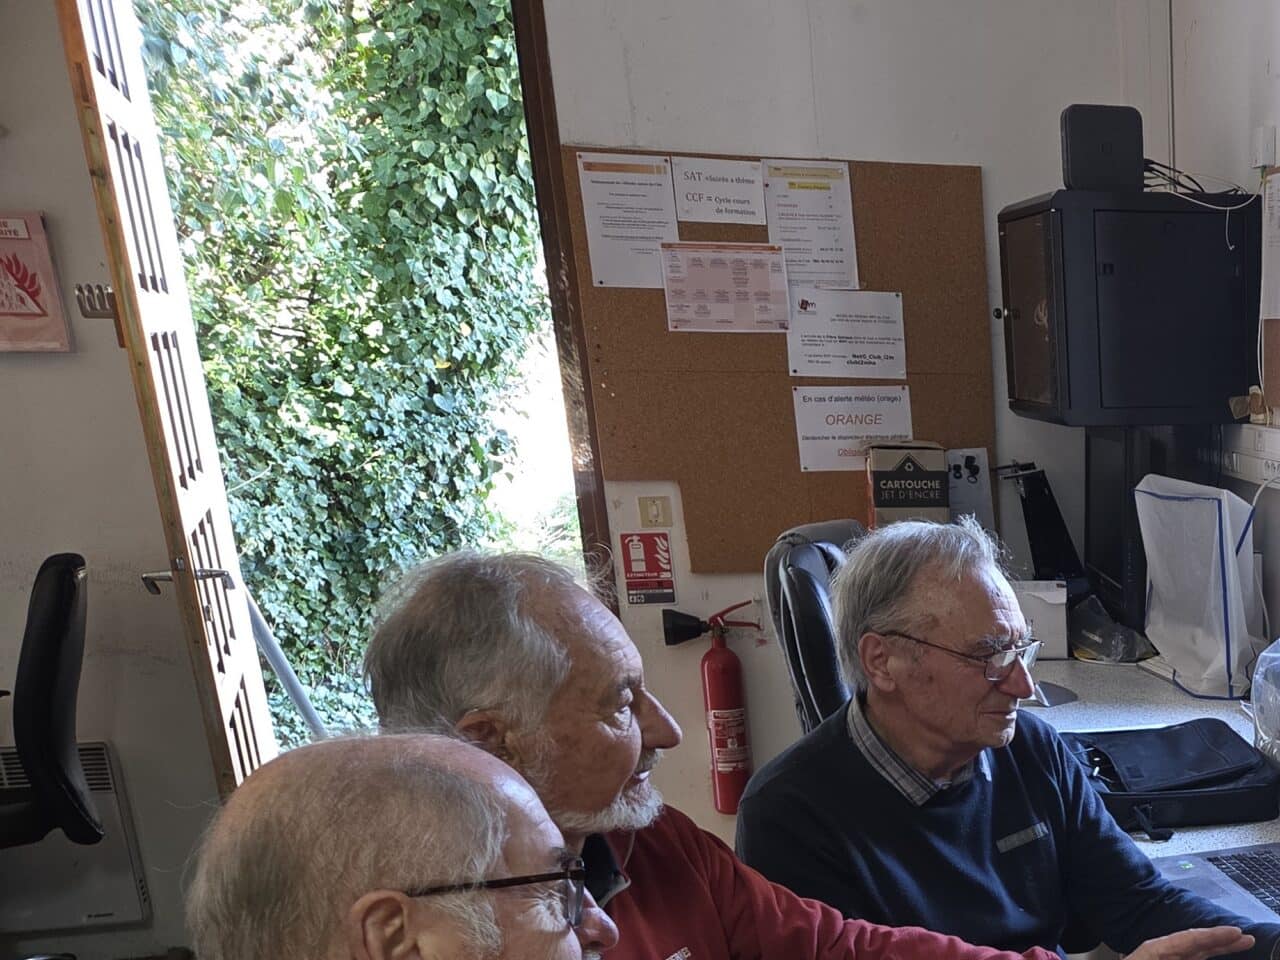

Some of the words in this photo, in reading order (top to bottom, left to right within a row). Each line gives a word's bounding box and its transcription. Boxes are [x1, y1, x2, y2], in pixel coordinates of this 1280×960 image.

[684, 170, 702, 181] SAT
[685, 192, 704, 203] CCF
[825, 414, 883, 426] ORANGE
[880, 480, 941, 490] CARTOUCHE
[881, 489, 897, 499] JET
[900, 489, 941, 499] D'ENCRE
